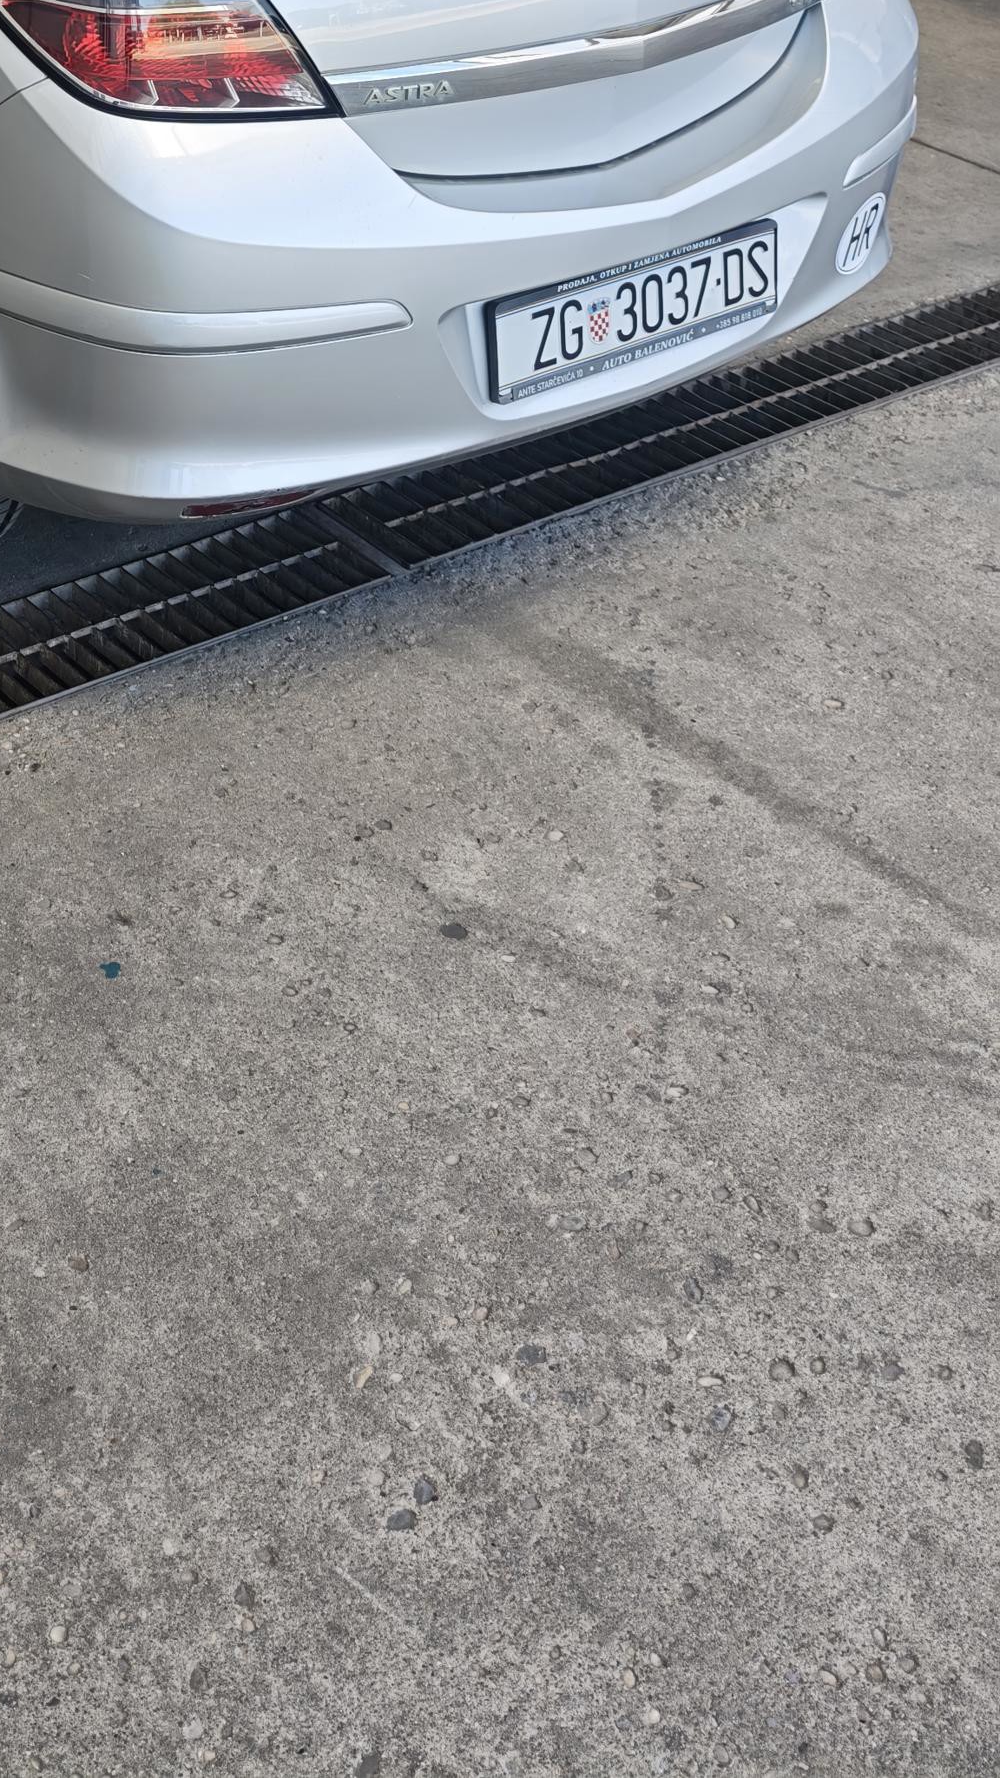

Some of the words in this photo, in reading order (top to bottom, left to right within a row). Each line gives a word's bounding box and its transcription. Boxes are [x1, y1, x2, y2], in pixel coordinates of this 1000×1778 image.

[363, 79, 454, 105] ASTRA
[843, 203, 879, 267] HR
[599, 265, 627, 279] OTKUP
[671, 235, 722, 256] AUTOMOBILA
[531, 299, 584, 371] ZG
[602, 353, 632, 371] AUTO
[634, 328, 694, 358] BALENOVIĆ
[517, 386, 536, 398] ANTE
[537, 372, 576, 393] STARČEVIĆA
